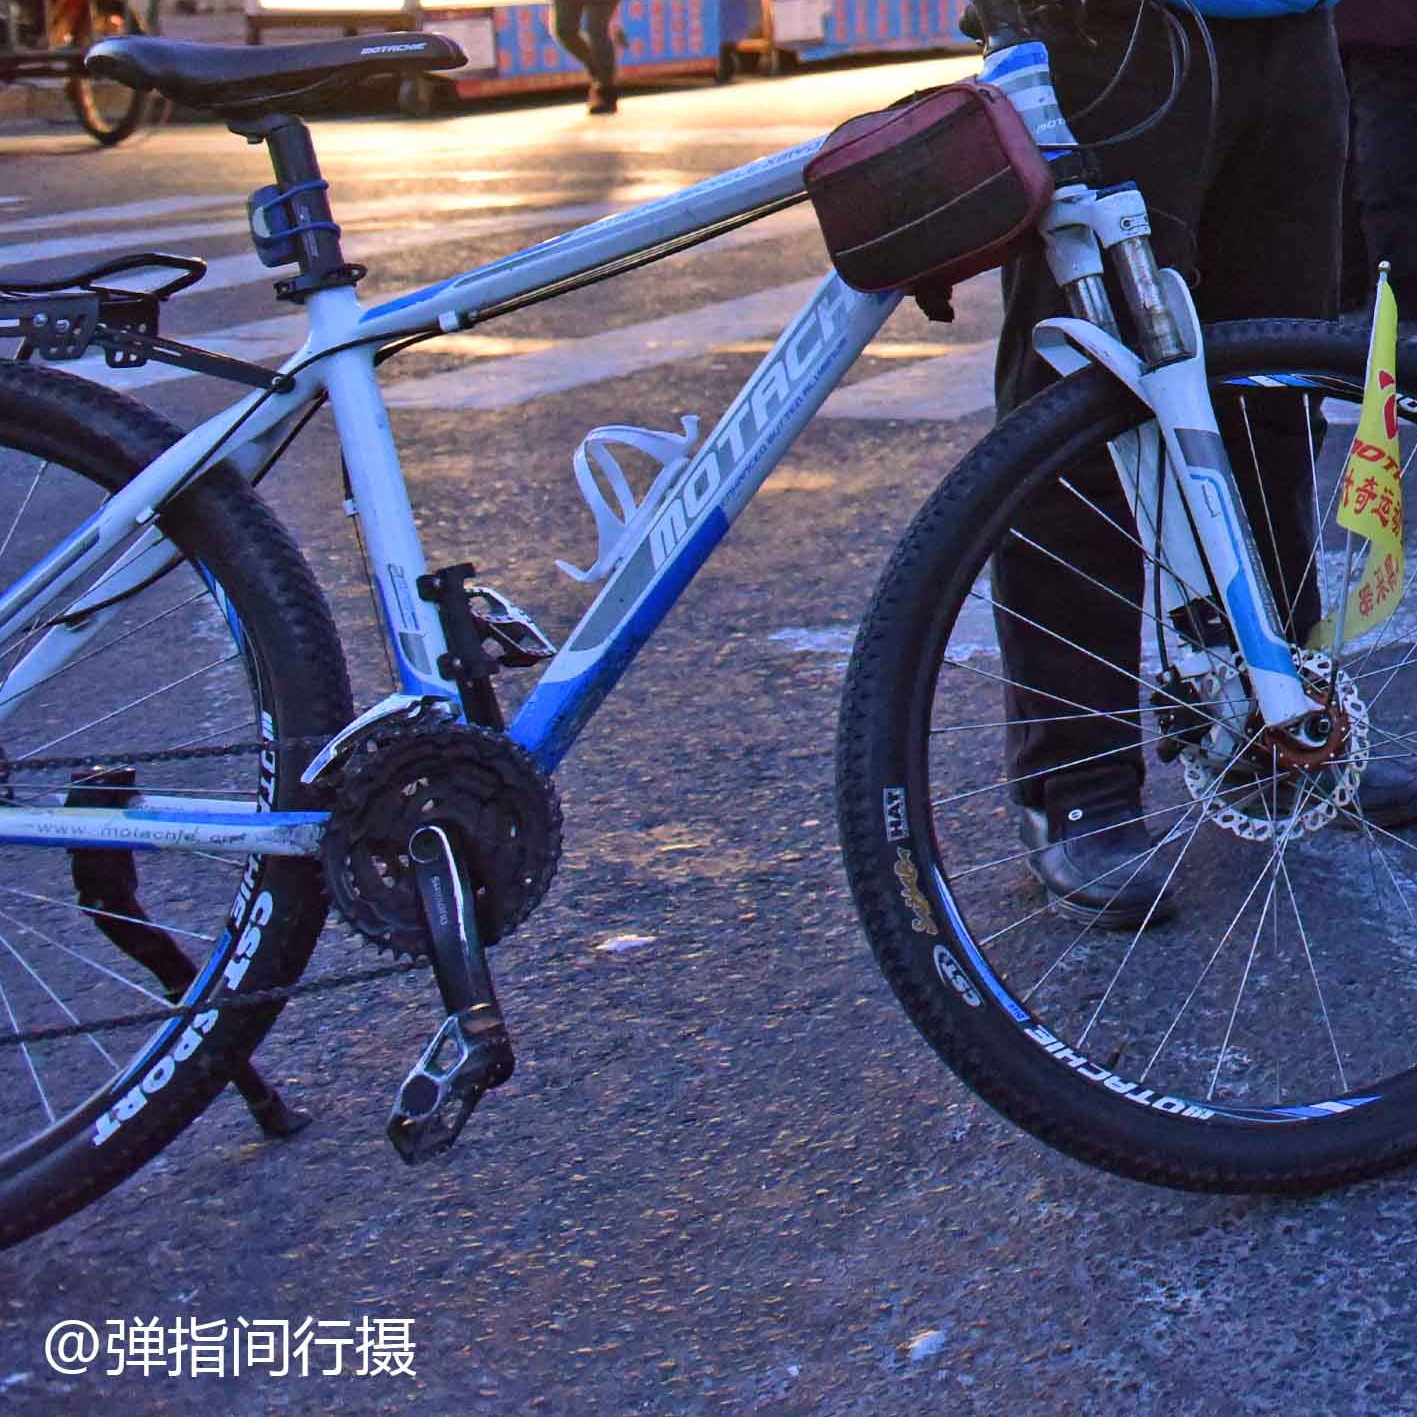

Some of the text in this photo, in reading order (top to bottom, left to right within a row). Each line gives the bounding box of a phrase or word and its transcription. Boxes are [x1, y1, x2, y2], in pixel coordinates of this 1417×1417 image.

[91, 890, 273, 1147] CST SPORT
[1023, 1024, 1216, 1121] MOTACHIE
